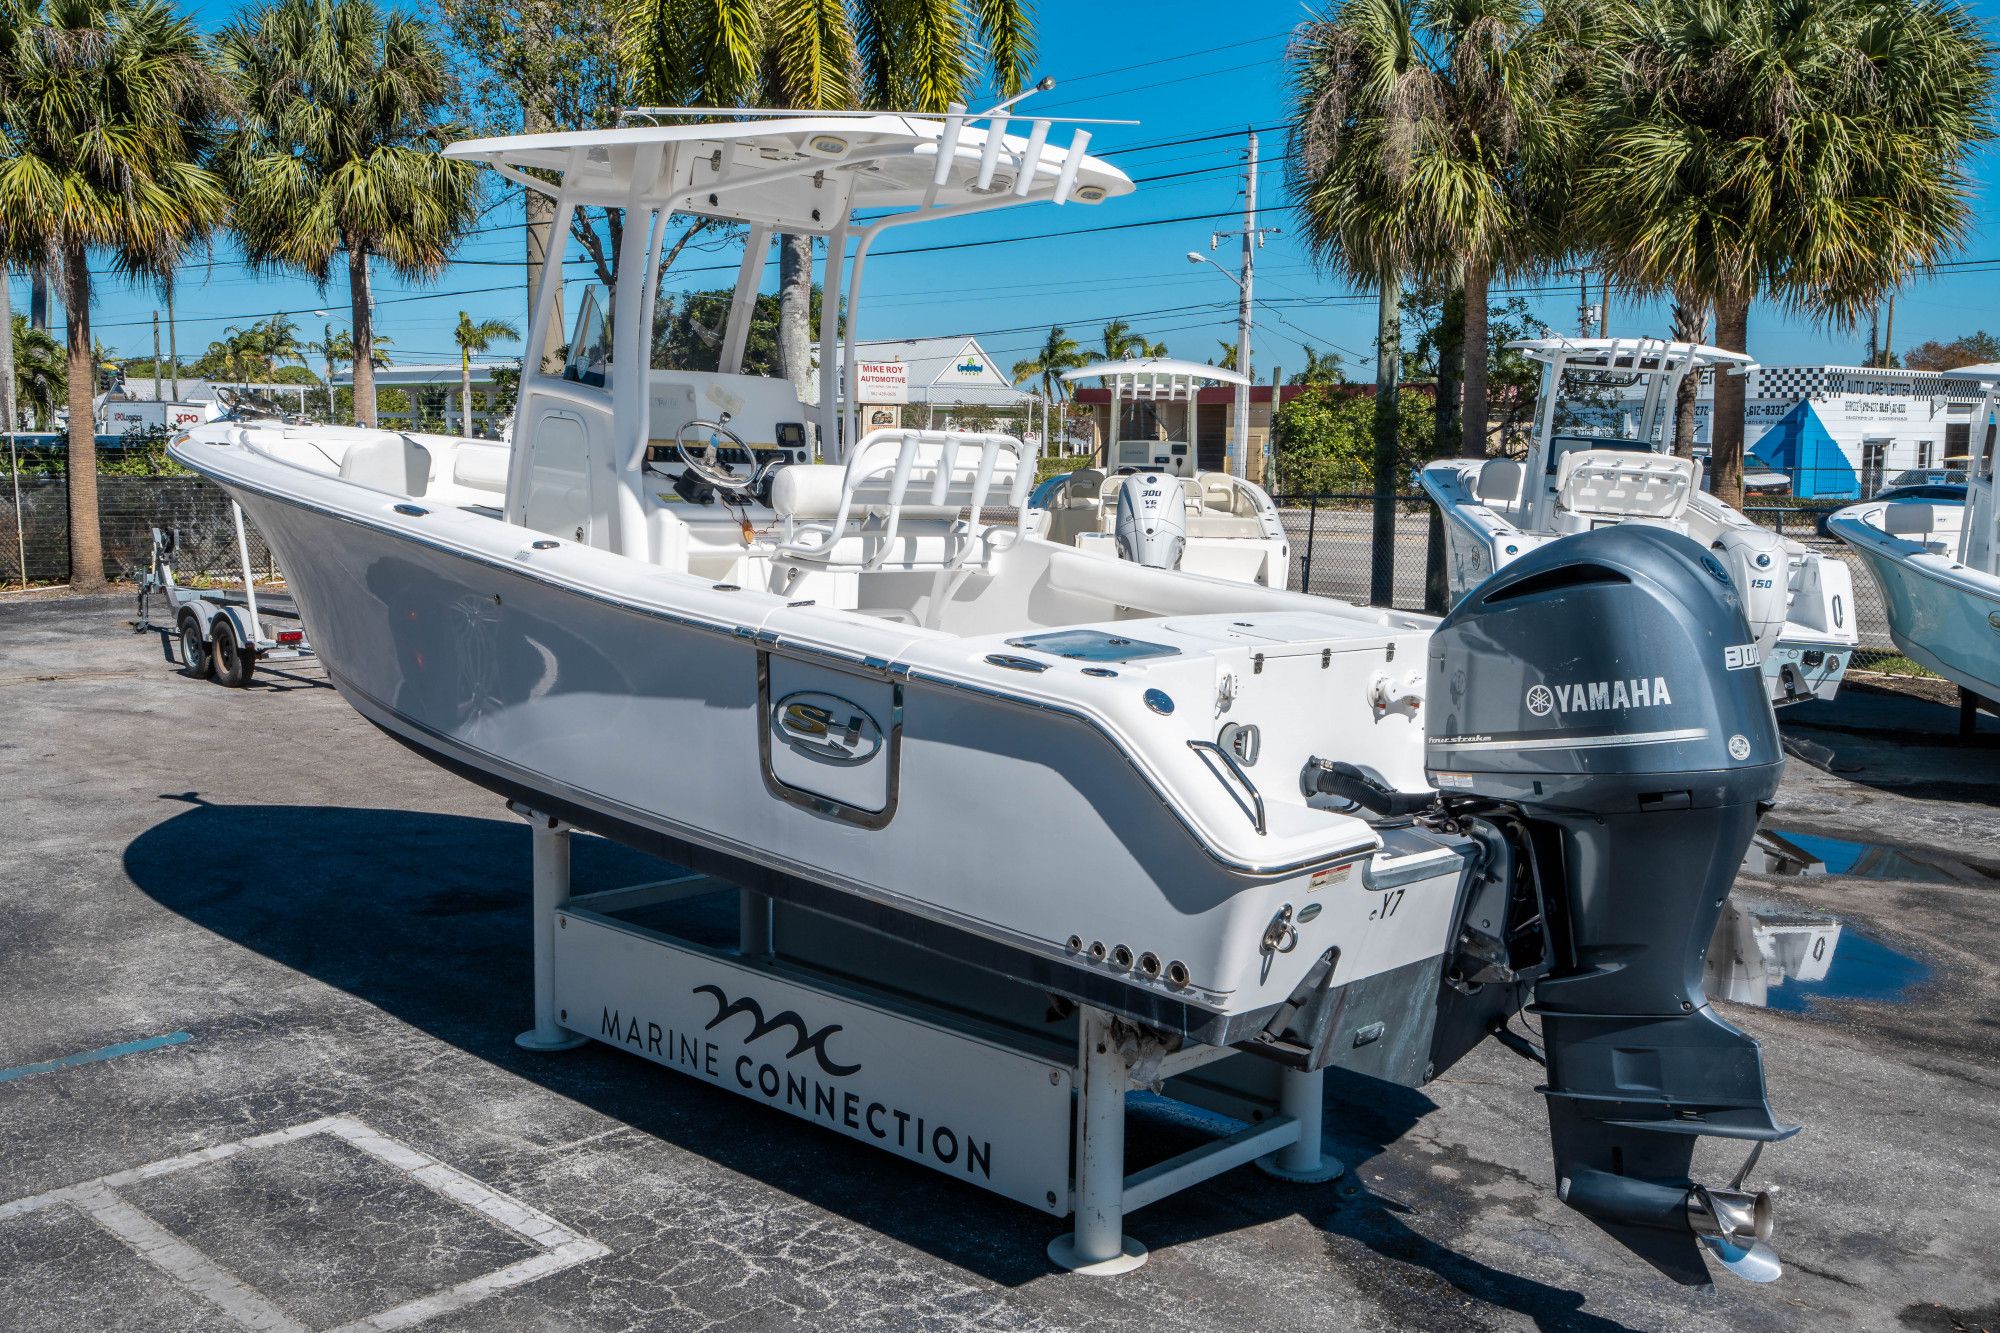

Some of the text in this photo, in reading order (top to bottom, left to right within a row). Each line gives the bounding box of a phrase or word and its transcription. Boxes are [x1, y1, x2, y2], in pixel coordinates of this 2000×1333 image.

[863, 365, 903, 374] MIKE ROY
[860, 375, 906, 384] AUTOMOTIVE
[1847, 380, 1911, 397] AUTO CARE CENTER
[176, 413, 198, 424] XPO
[1141, 489, 1161, 497] 300
[1751, 579, 1772, 589] 150
[1555, 676, 1672, 713] YAMAHA
[601, 1005, 992, 1181] MARINE CONNECTION
